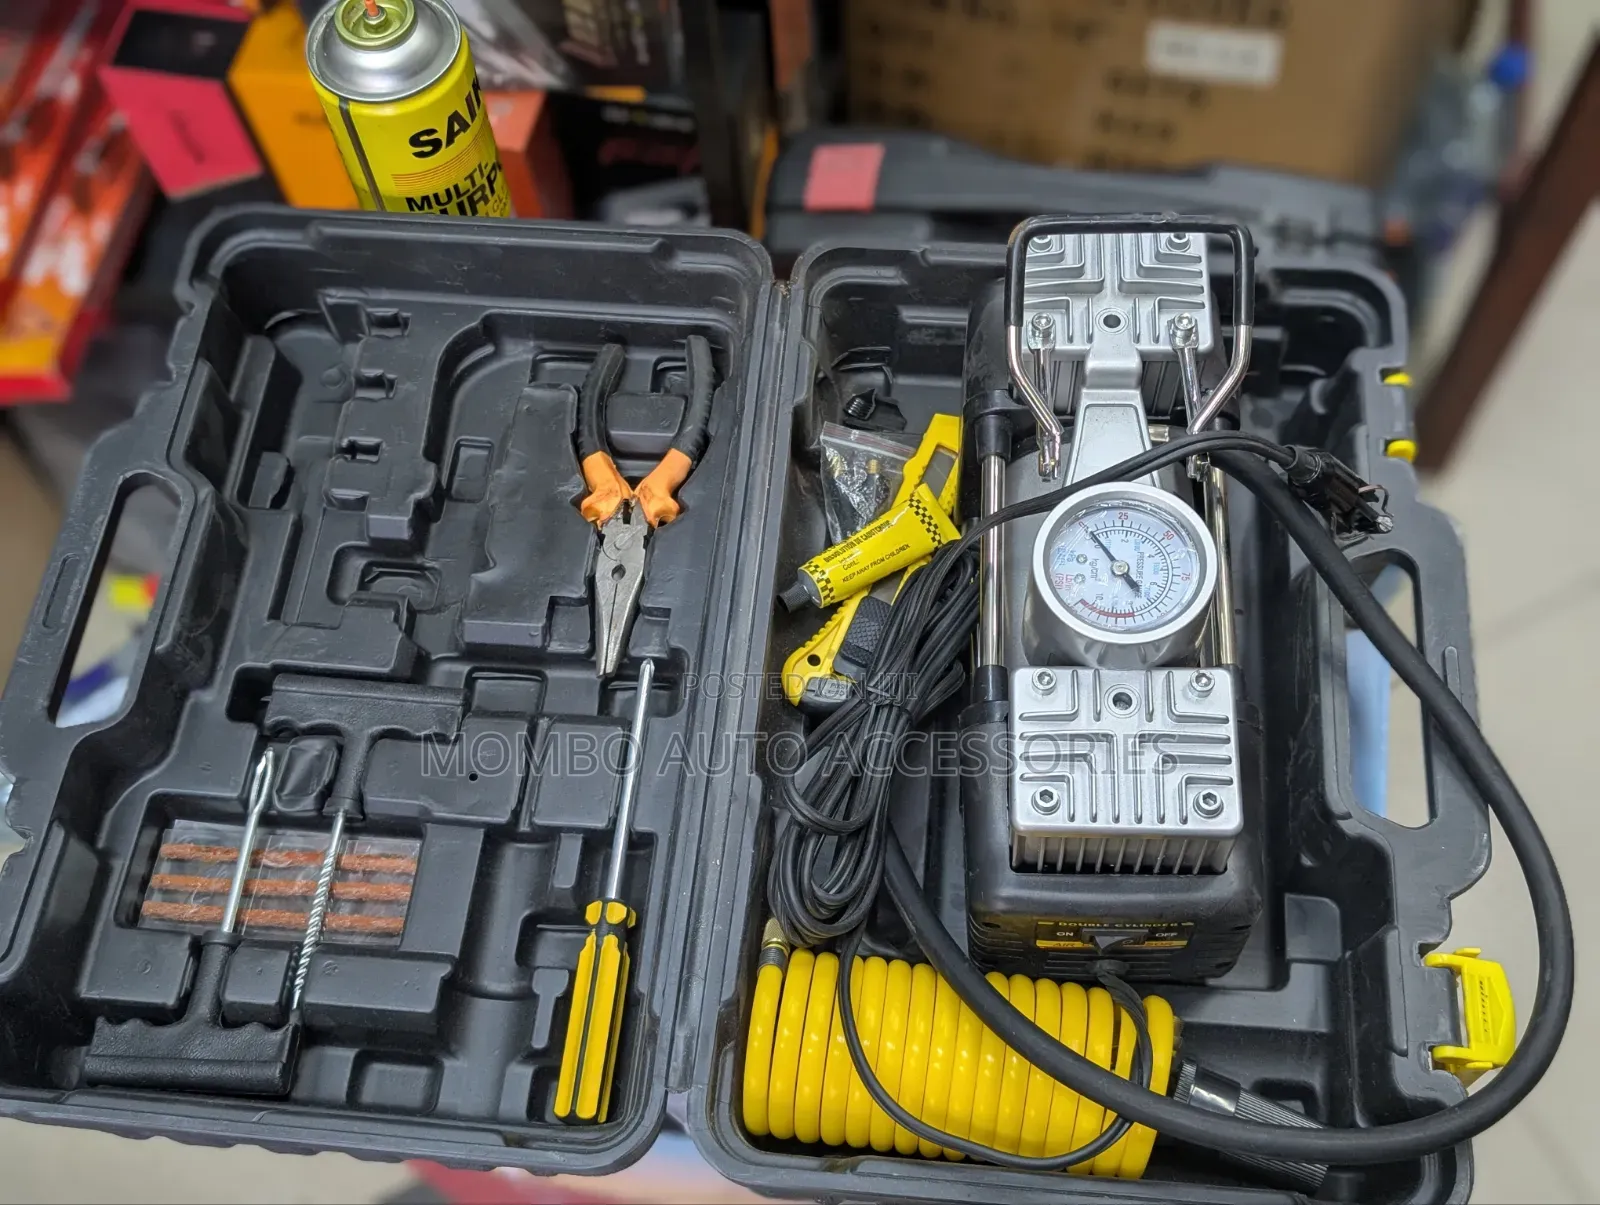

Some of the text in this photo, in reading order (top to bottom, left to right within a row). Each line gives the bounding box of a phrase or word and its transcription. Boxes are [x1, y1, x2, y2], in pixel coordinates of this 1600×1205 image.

[405, 162, 489, 212] MULTI-
[1118, 511, 1129, 520] 25
[1163, 529, 1175, 541] 50
[842, 543, 911, 583] KEEP AWAY FROM CHILDREN
[1135, 552, 1144, 579] PRESSURE
[1181, 572, 1191, 581] 75
